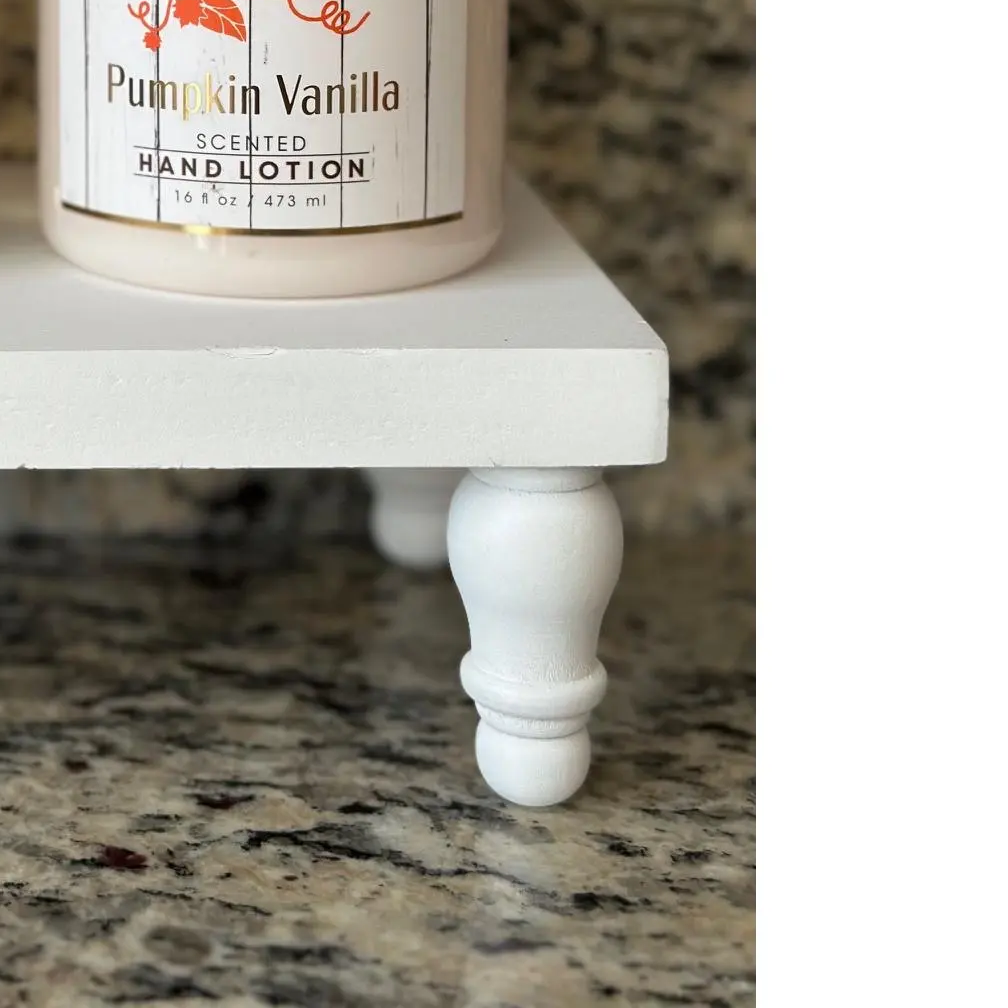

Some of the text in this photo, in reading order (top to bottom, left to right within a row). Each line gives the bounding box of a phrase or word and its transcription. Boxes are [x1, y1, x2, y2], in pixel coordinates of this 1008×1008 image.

[107, 62, 400, 122] Pumpkin Vanilla
[196, 133, 307, 152] SCENTED
[139, 153, 365, 181] HAND LOTION
[175, 189, 193, 203] 16
[202, 192, 209, 204] fl
[218, 195, 237, 206] oz
[264, 194, 296, 207] 473
[306, 194, 327, 206] ml
